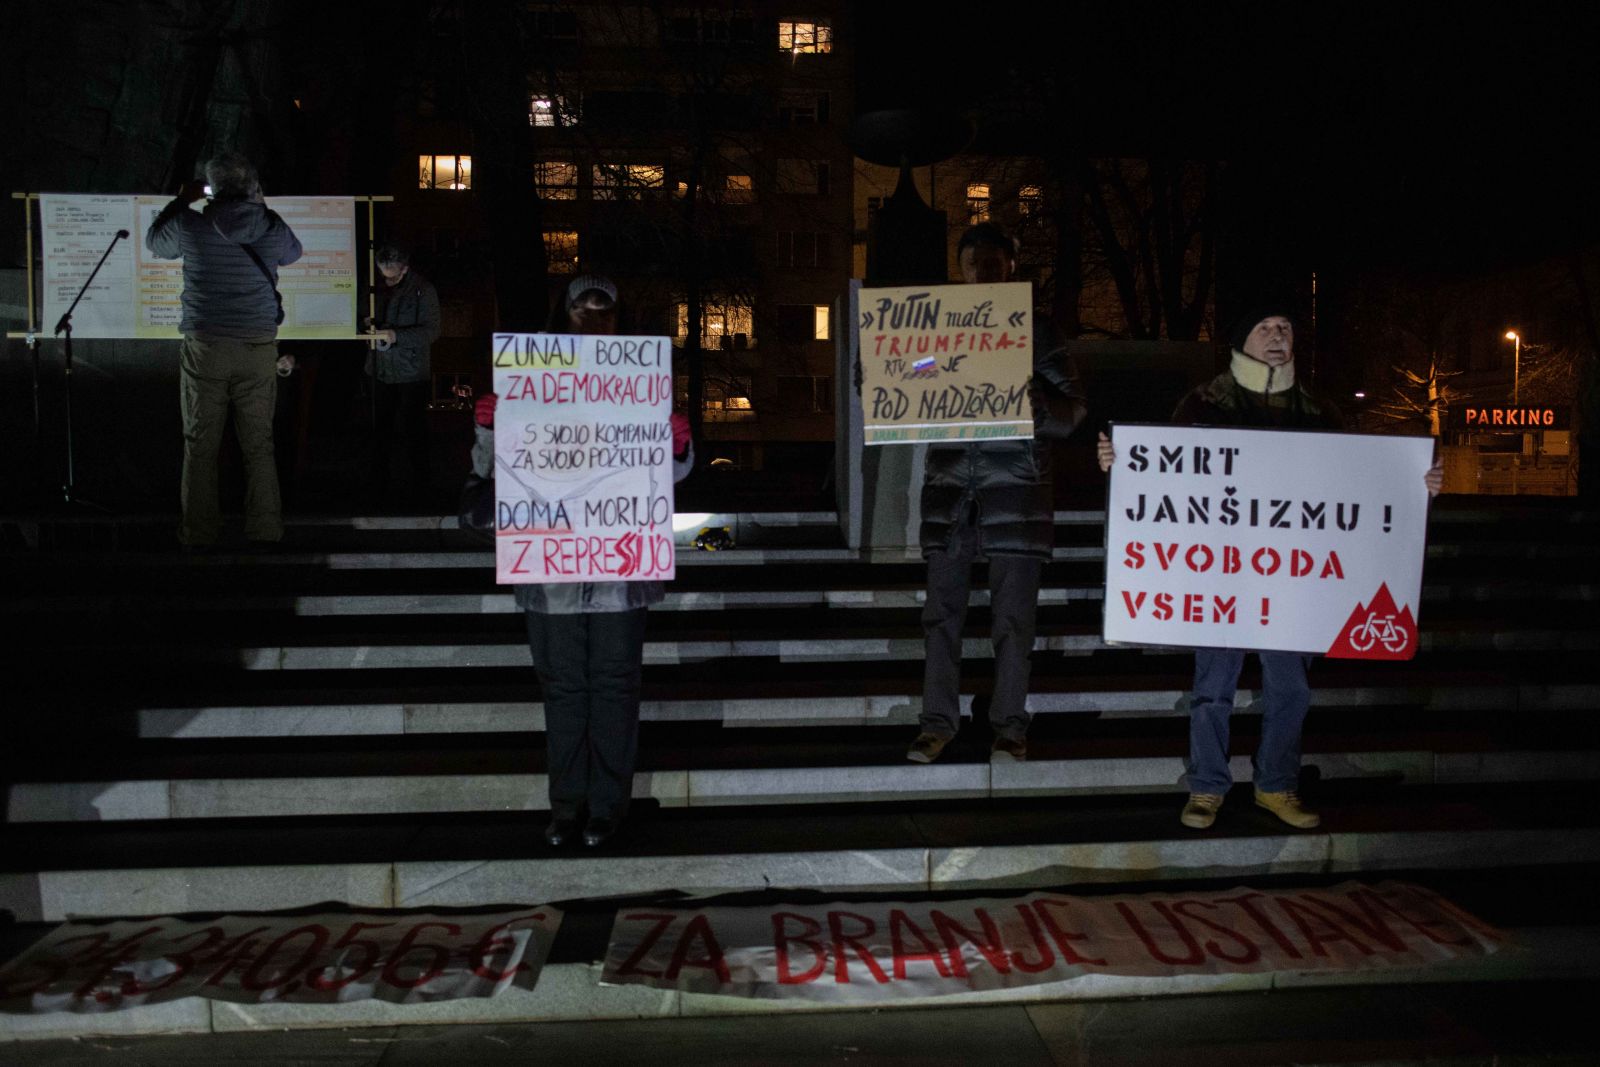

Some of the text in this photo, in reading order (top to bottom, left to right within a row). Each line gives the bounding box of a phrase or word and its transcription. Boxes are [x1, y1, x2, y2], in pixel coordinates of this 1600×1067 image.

[495, 335, 661, 367] ZUNAJ BORCI
[505, 372, 671, 406] ZA DEMOKRACIJO
[523, 422, 672, 444] S SVOJO KOMPANIJO
[1465, 408, 1555, 426] PARKING
[512, 445, 664, 470] ZA SVOJO POŽRTIJO
[1128, 444, 1239, 475] SMRT
[499, 496, 668, 529] DOMA MORIJO
[1125, 486, 1360, 531] JANŠIZMU
[511, 540, 532, 574] Z
[1124, 541, 1344, 579] SVOBODA
[1121, 590, 1236, 624] VSEM
[617, 910, 730, 983] ZA
[772, 896, 1107, 984] BRANJE
